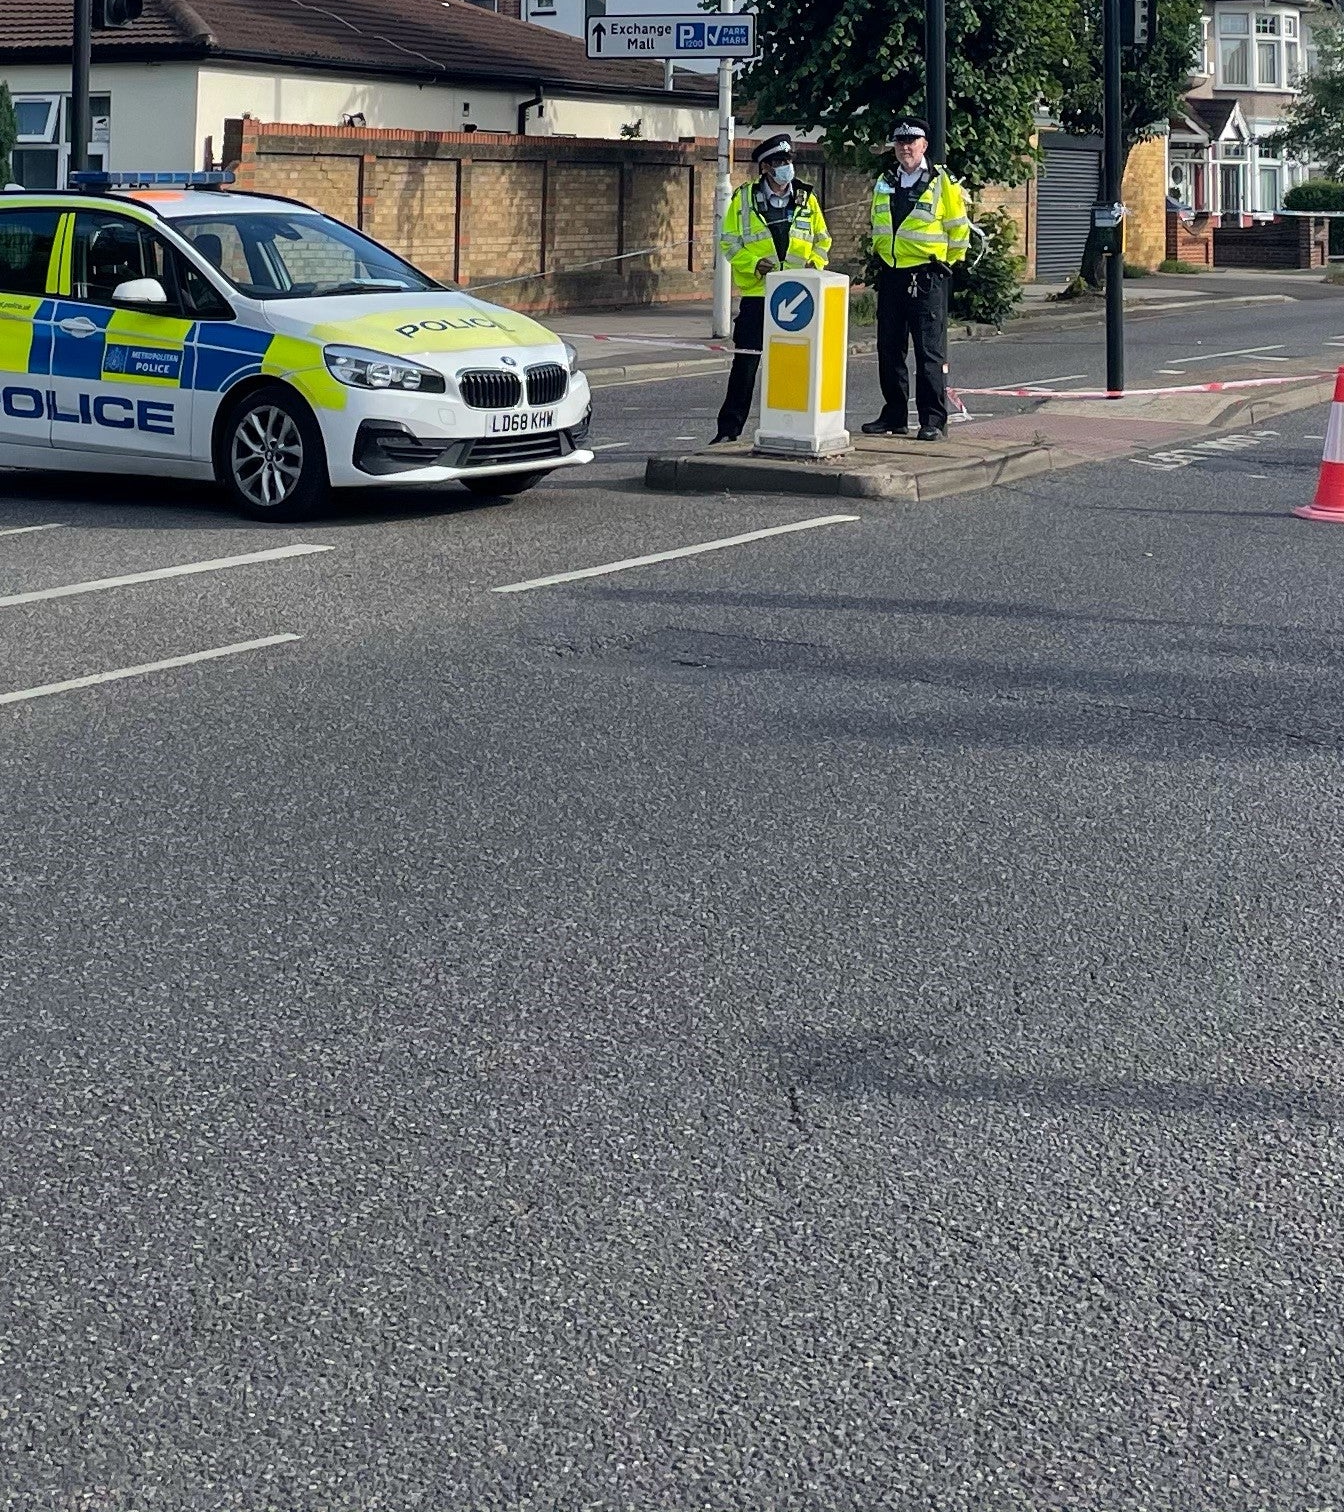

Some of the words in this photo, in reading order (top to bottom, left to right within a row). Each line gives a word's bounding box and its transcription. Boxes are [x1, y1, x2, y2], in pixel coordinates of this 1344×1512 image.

[610, 23, 672, 37] Exchange
[723, 27, 746, 35] PARK
[627, 38, 655, 50] Mall
[721, 36, 746, 44] MARK
[131, 351, 179, 362] METROPOLITAN
[135, 362, 170, 374] POLICE
[492, 412, 528, 433] LD68
[530, 409, 554, 430] KHW
